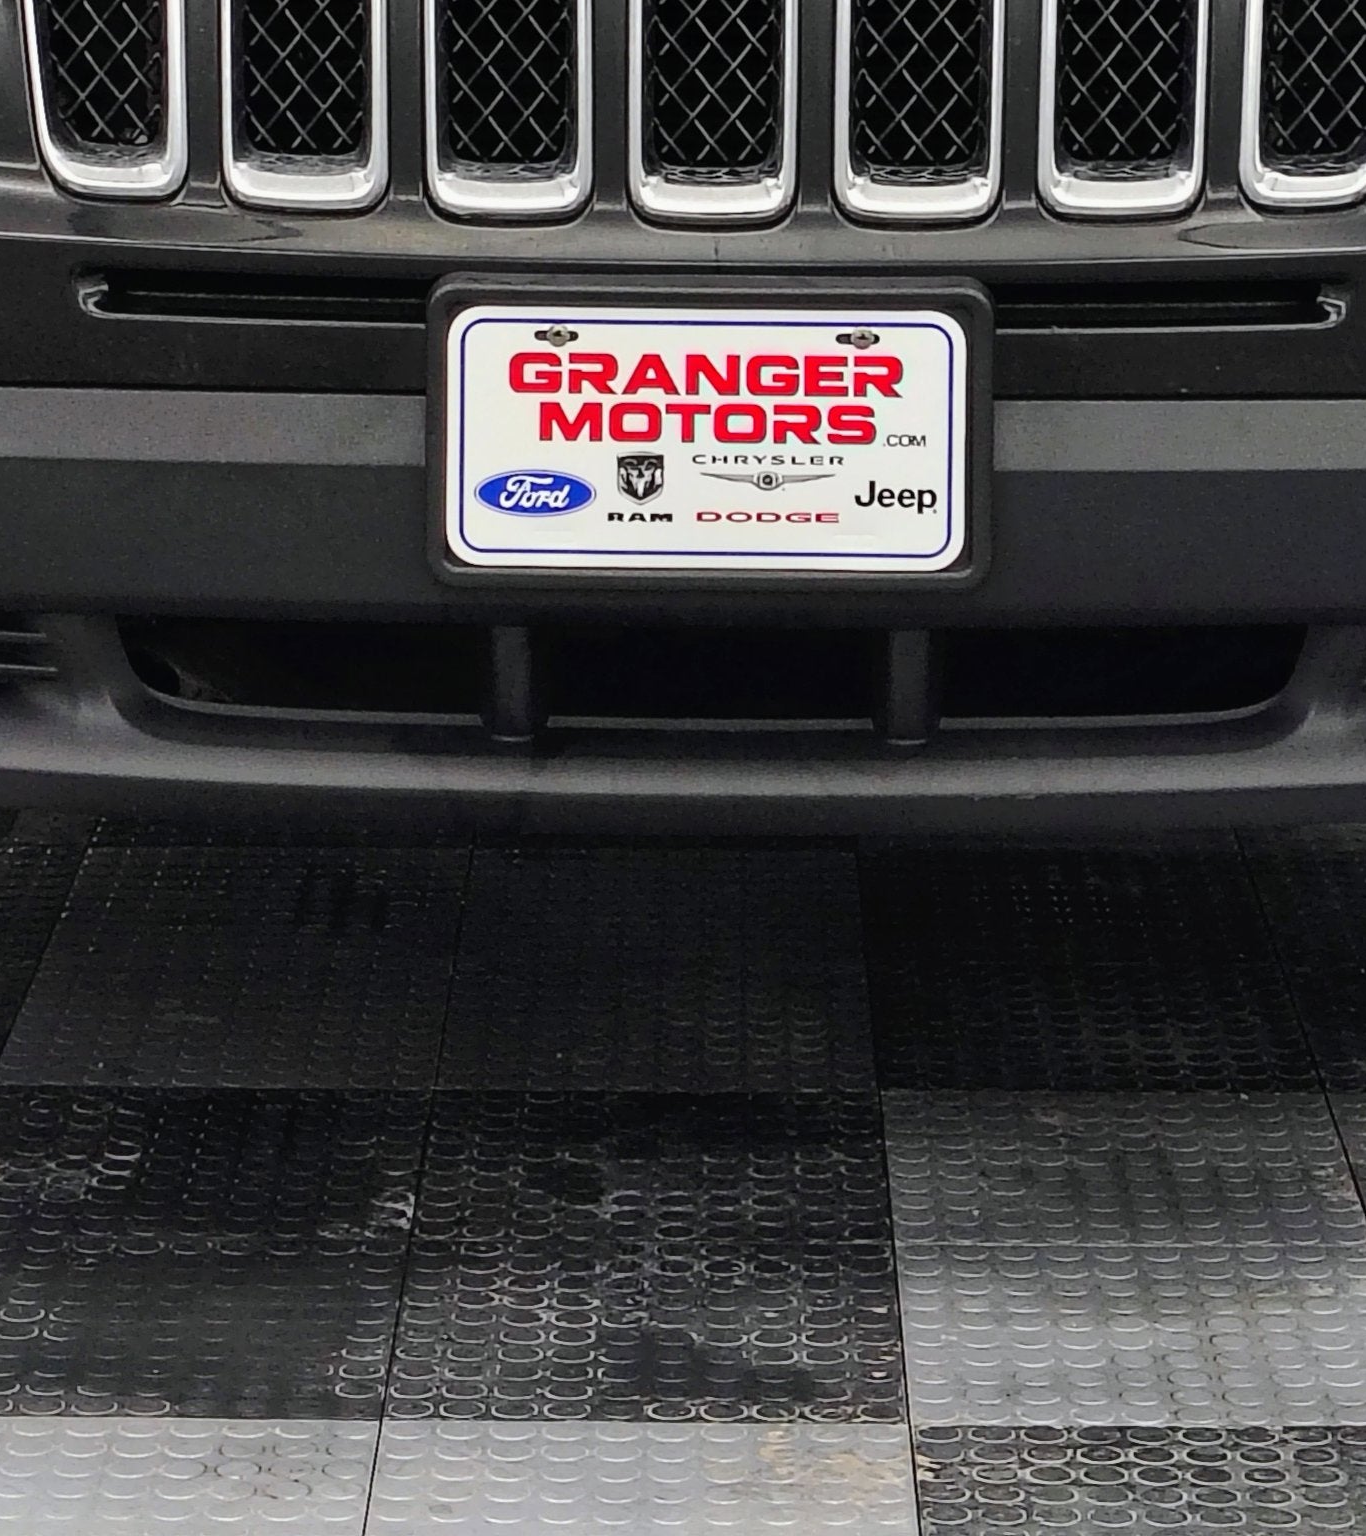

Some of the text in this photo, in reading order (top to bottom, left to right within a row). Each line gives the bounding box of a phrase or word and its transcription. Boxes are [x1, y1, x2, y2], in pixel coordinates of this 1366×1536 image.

[508, 351, 904, 399] GRANGER
[538, 401, 878, 446] MOTORS
[691, 454, 845, 466] CHRYSLER
[499, 474, 571, 509] Ford
[853, 480, 938, 514] Jeep
[607, 511, 674, 523] RAM
[695, 511, 841, 524] DODGE
